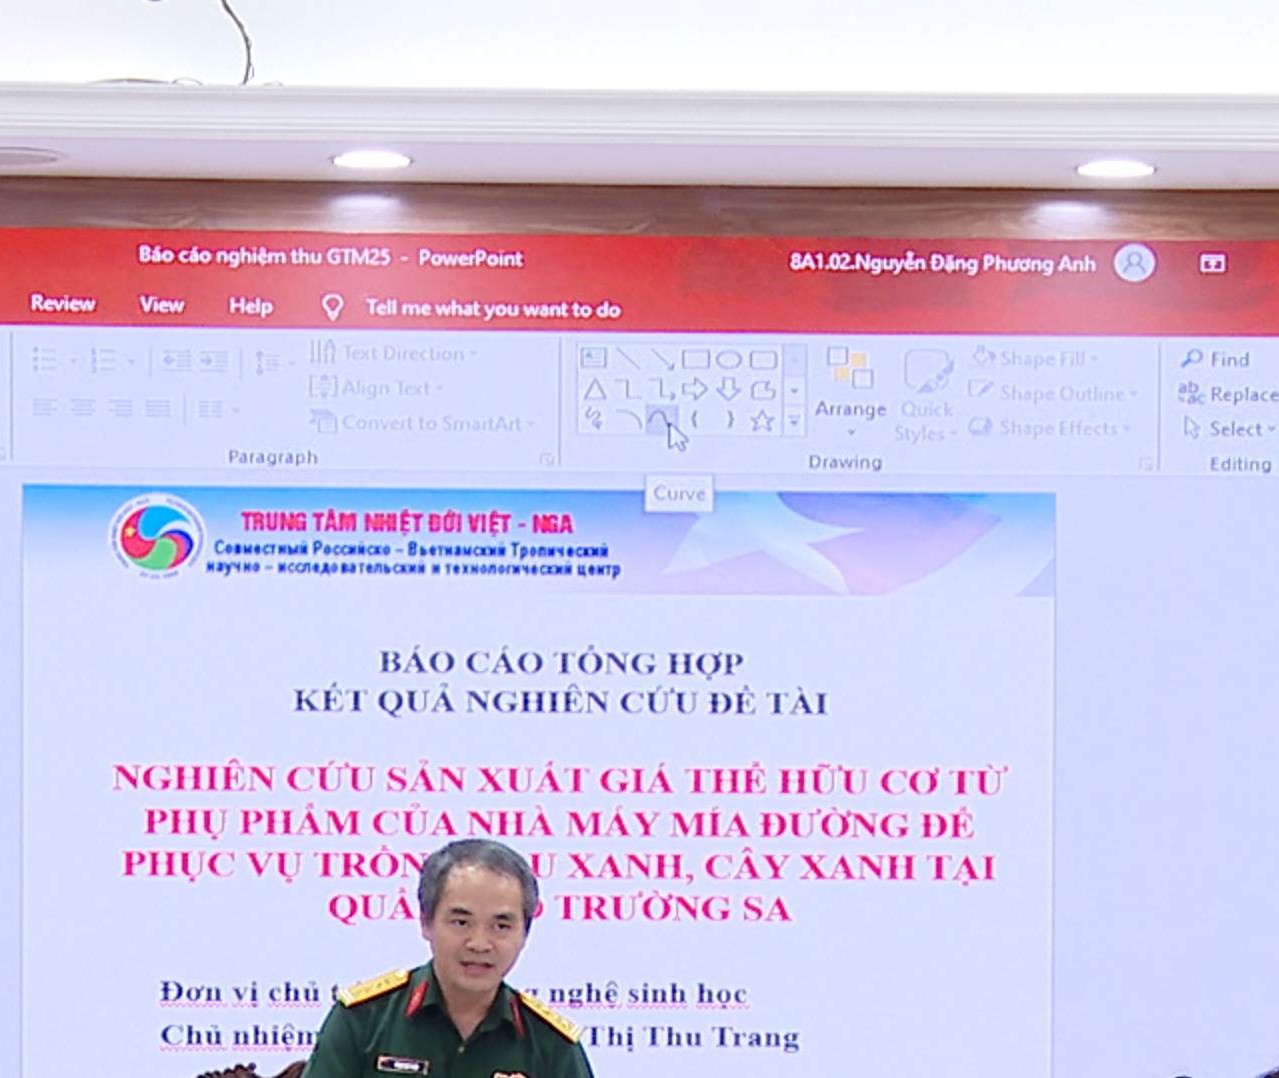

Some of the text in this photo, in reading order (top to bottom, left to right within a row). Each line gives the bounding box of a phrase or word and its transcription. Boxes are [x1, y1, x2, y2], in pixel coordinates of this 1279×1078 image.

[138, 244, 176, 262] Báo
[178, 246, 212, 263] cáo
[214, 247, 286, 267] nghiệm
[290, 247, 322, 264] thu
[326, 247, 392, 265] GTM25
[420, 249, 524, 267] PowerPoint
[931, 254, 978, 276] Đặng
[984, 255, 1054, 275] Phương
[1058, 256, 1095, 271] Anh
[30, 294, 95, 311] Review
[140, 295, 184, 313] View
[228, 297, 273, 318] Help
[366, 298, 622, 321] Tell me what you want to do
[344, 345, 464, 361] Text Direction
[1001, 351, 1085, 370] Shape Fill
[1212, 352, 1249, 367] Find
[342, 378, 432, 398] Align Text
[1000, 384, 1124, 406] Shape Outline
[1212, 387, 1279, 405] Replace
[815, 401, 886, 421] Arrange
[901, 401, 953, 418] Quick
[341, 415, 521, 431] Convert to SmartArt
[1001, 419, 1121, 440] Shape Effects
[1211, 421, 1262, 437] Select
[895, 425, 944, 445] Styles
[229, 450, 318, 466] Paragraph
[806, 455, 882, 472] Drawing
[1211, 457, 1271, 474] Editing
[654, 485, 705, 501] Curve
[241, 511, 307, 532] TRUNG
[312, 509, 357, 532] TÂM
[364, 508, 424, 536] NHIỆT
[428, 509, 462, 533] ĐỚI
[467, 510, 512, 536] VIỆT
[532, 514, 573, 534] NGA
[382, 646, 743, 680] BÁO CÁO TỔNG HỢP
[296, 683, 827, 717] KẾT QUẢ NGHIÊN CỨU ĐỀ TÀI
[114, 758, 1008, 795] NGHIÊN CỨU SẢN XUẤT GIÁ THỂ HỮU CƠ TỪ
[146, 803, 973, 840] PHỤ PHẨM CỦA NHÀ MÁY MÍA ĐƯỜNG ĐỂ
[124, 852, 234, 882] PHỤC
[247, 852, 301, 883] VỤ
[314, 845, 426, 878] TRỒN
[569, 854, 694, 883] XANH,
[705, 847, 789, 880] CÂY
[800, 855, 914, 880] XANH
[927, 856, 993, 885] TẠI
[328, 886, 415, 925] QUẦ
[555, 891, 730, 920] TRƯỜNG
[744, 897, 791, 921] SA
[629, 982, 686, 1003] sinh
[161, 1025, 221, 1045] Chủ
[586, 1026, 633, 1052] Thị
[645, 1026, 702, 1047] Thu
[712, 1026, 800, 1054] Trang
